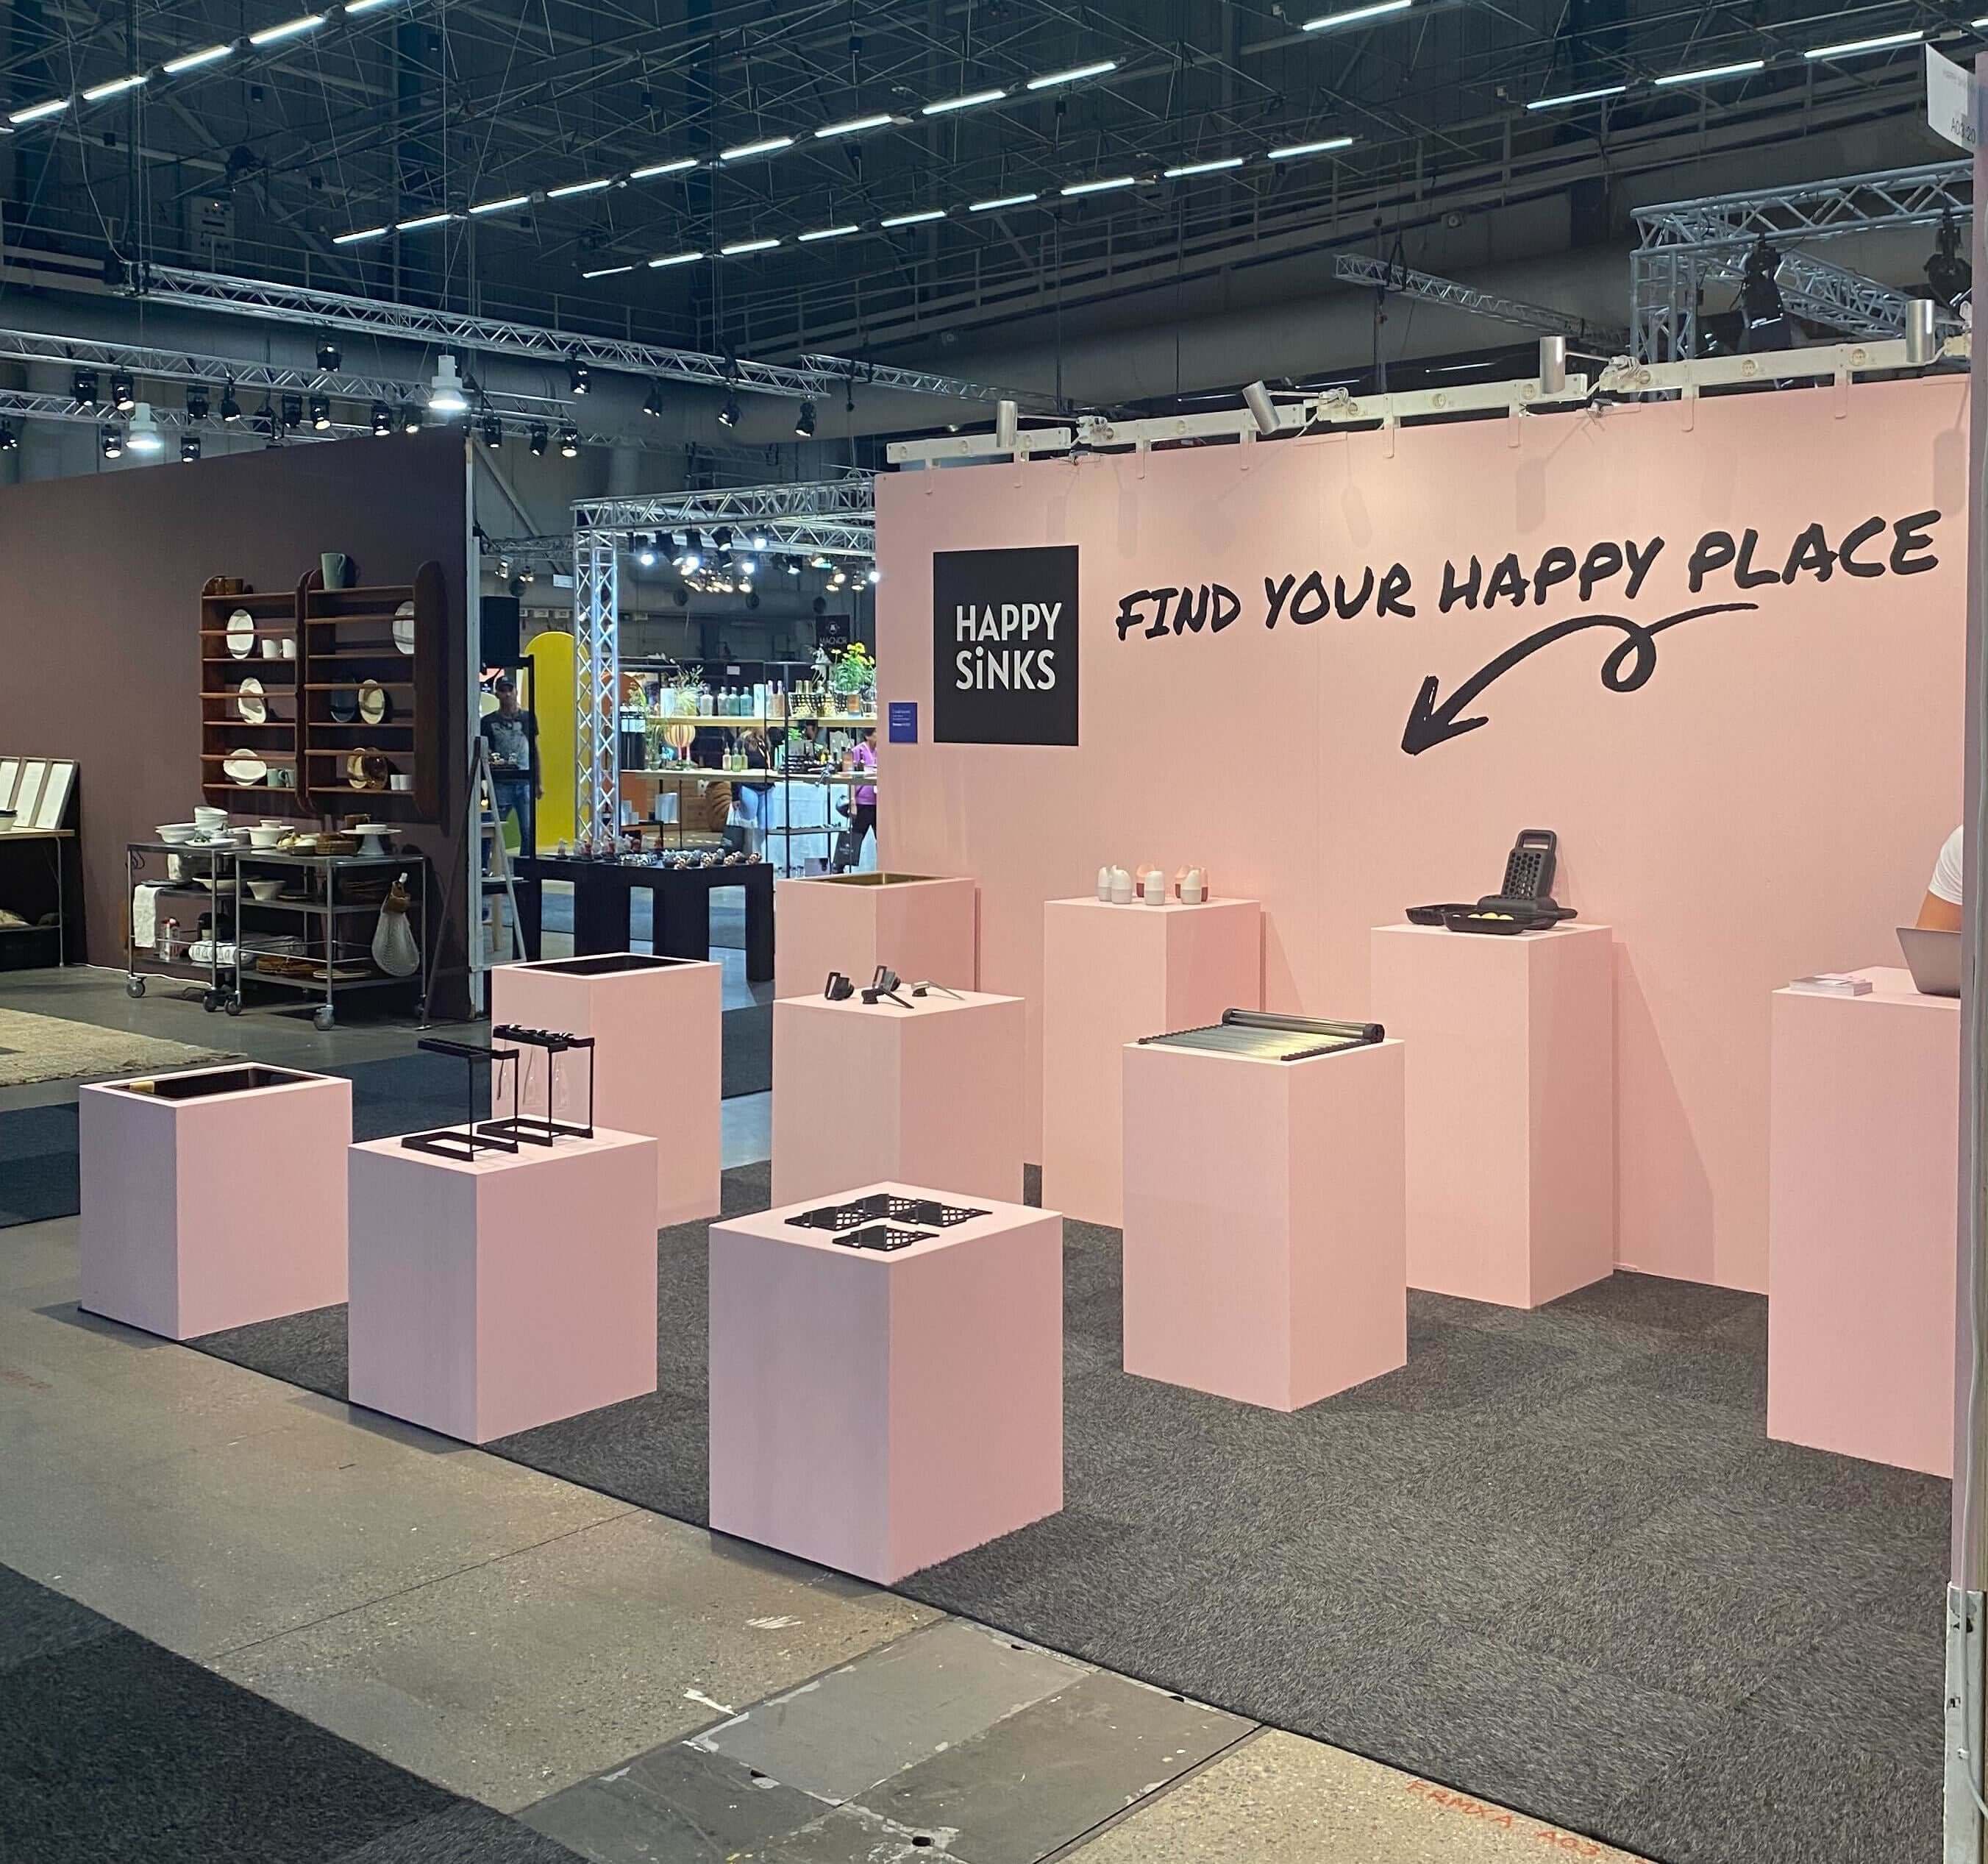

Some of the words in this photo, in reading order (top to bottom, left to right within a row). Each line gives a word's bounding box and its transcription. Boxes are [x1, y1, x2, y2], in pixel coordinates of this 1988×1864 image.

[1115, 583, 1241, 641] FIND
[1264, 562, 1417, 630] YOUR
[1438, 536, 1666, 613] HAPPY
[1688, 509, 1942, 594] PLACE
[955, 602, 1063, 642] HAPPY
[955, 645, 1057, 691] SiNKS
